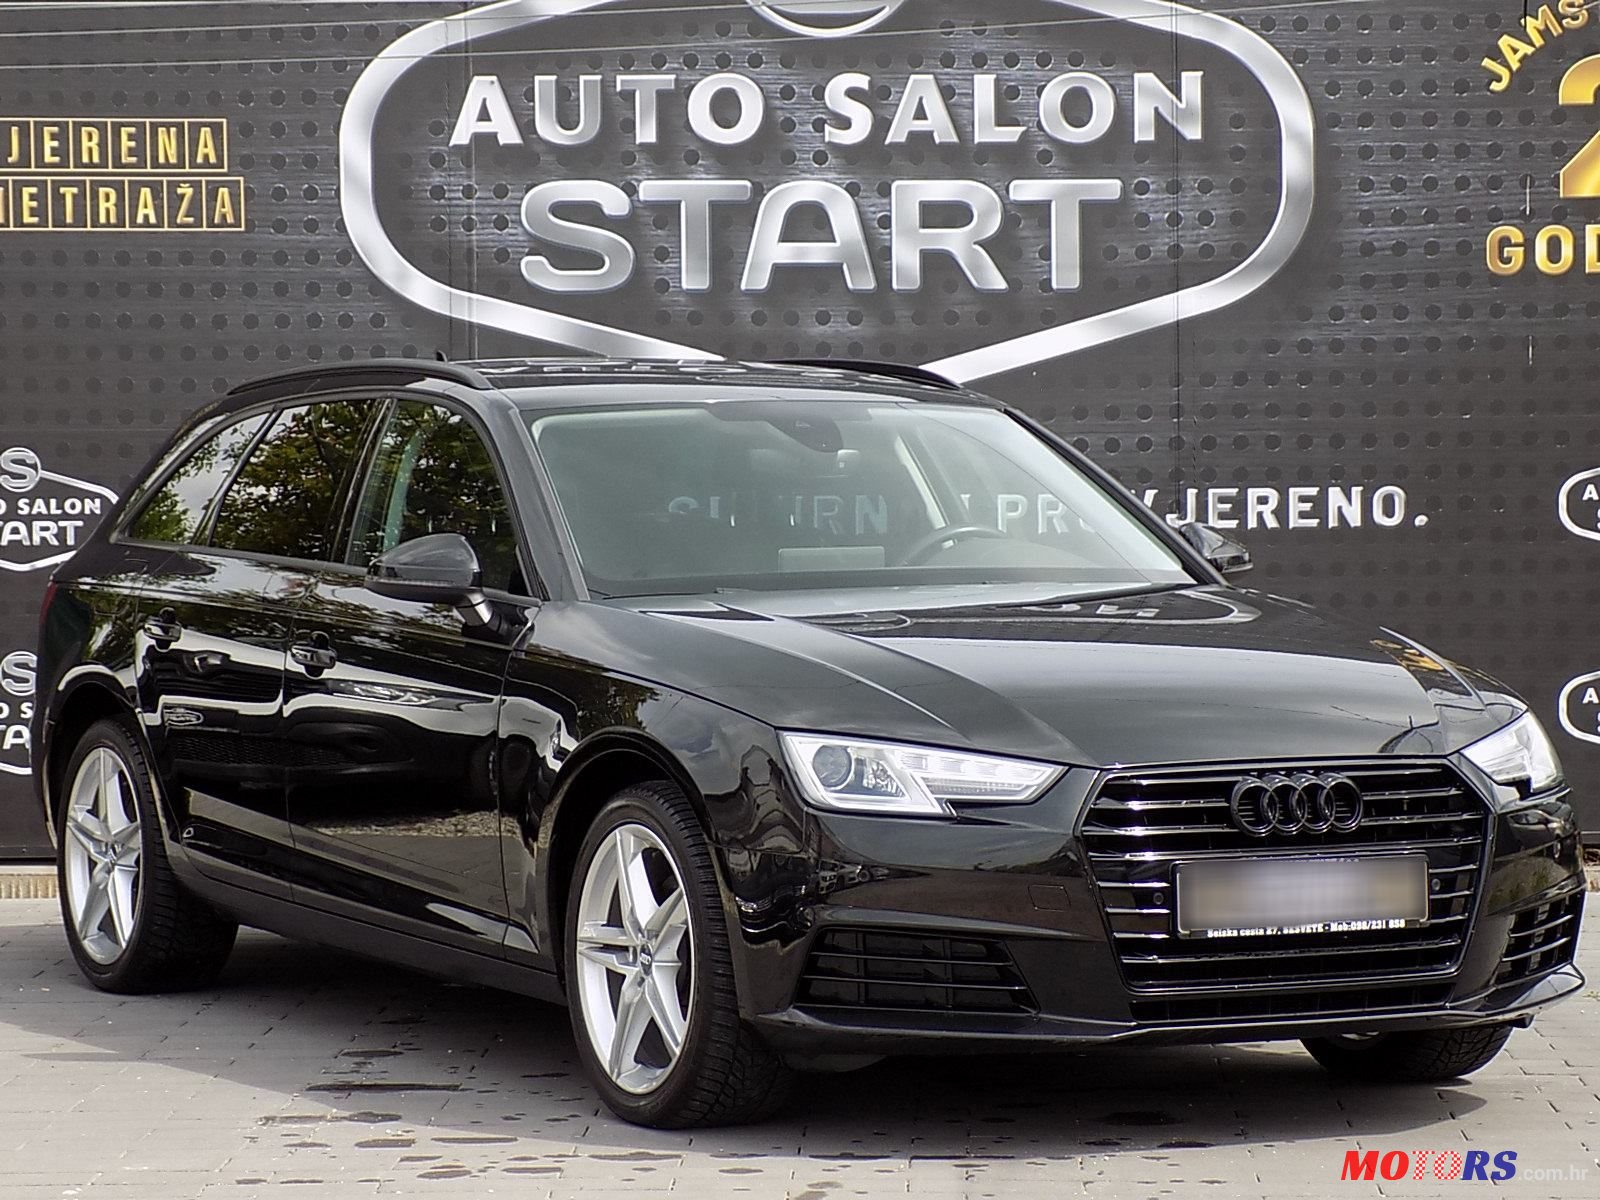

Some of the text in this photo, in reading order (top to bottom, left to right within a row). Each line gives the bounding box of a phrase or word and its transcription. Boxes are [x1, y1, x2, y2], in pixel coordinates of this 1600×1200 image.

[449, 71, 1204, 147] AUTO SALON
[7, 126, 217, 164] JERENA
[0, 183, 235, 224] ETRAŽA
[520, 179, 1122, 292] START
[17, 498, 101, 515] SALON
[0, 521, 84, 546] ART
